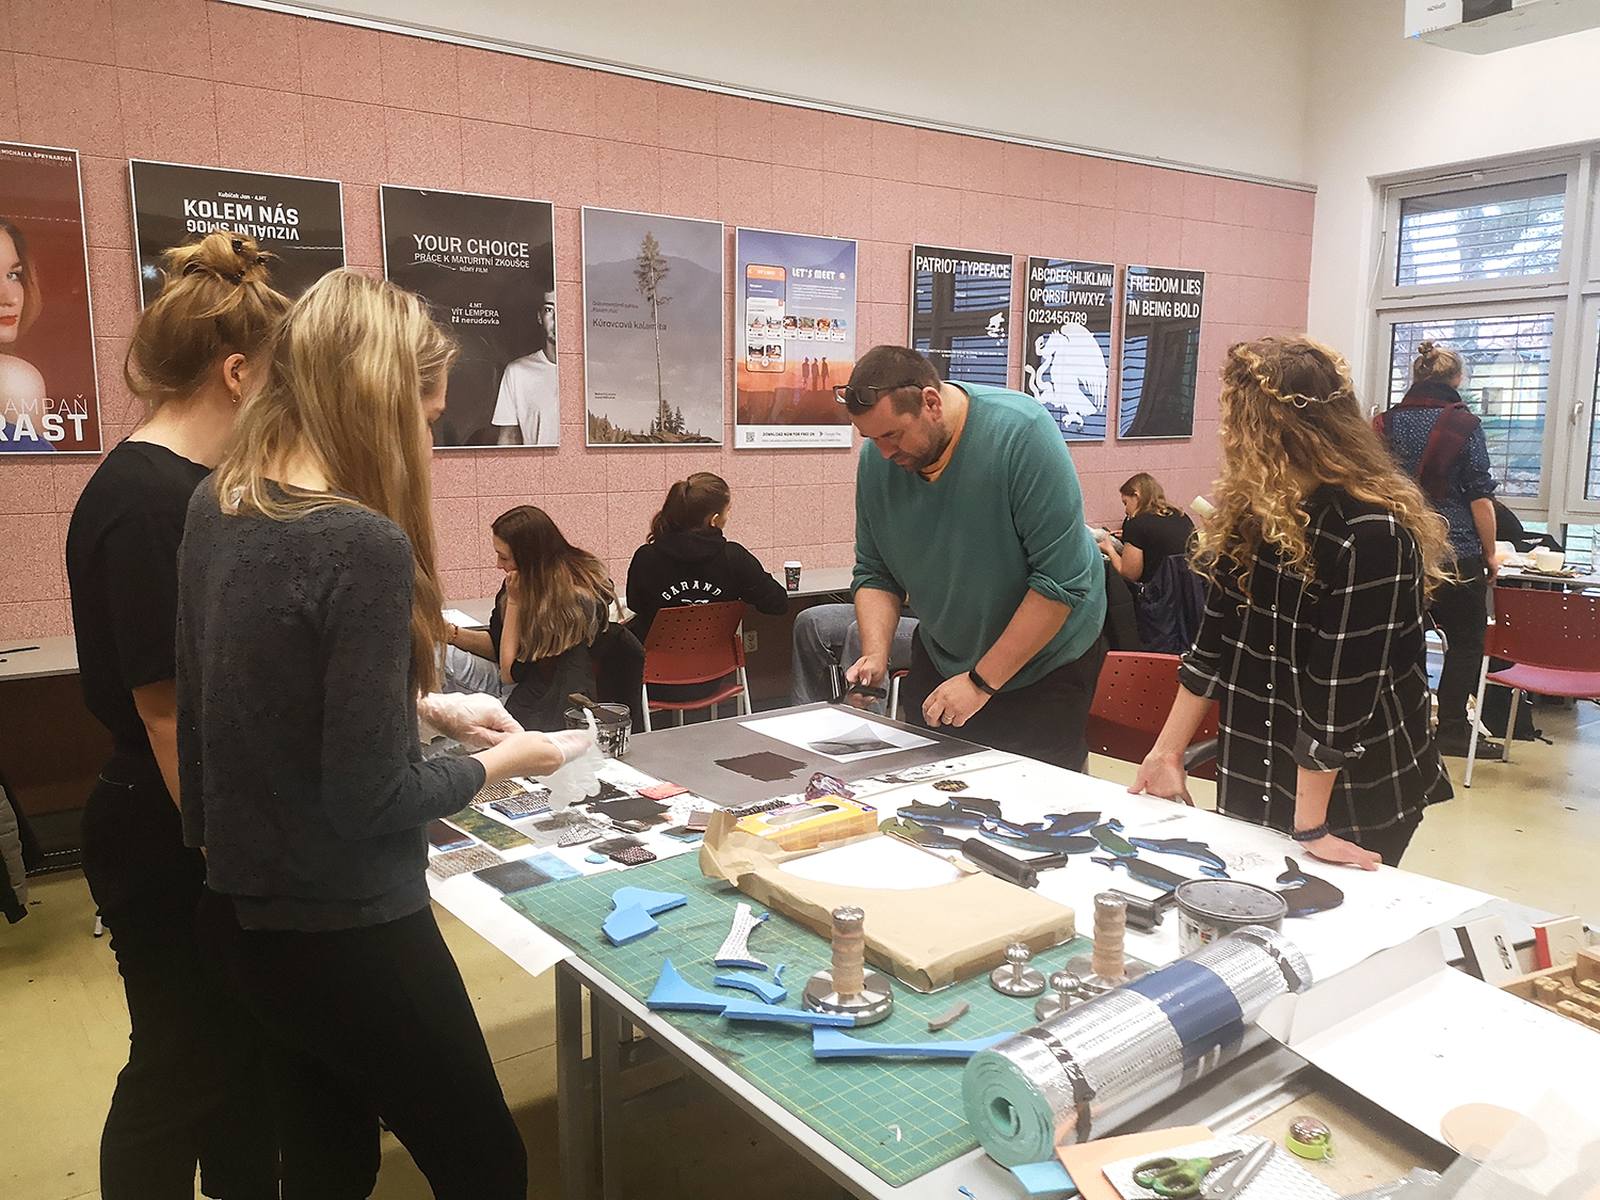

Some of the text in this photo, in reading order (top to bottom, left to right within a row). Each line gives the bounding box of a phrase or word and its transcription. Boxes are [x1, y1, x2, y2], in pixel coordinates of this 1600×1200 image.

[183, 199, 299, 225] KOLEM NÁS
[413, 234, 529, 258] YOUR CHOICE
[414, 252, 530, 269] PRÁCE K MATURITNÍ ZKOUŠCE
[916, 256, 1010, 279] PATRIOT TYPEFACE
[791, 267, 836, 280] LET'S MEET
[1031, 267, 1112, 287] ABCDEFGHIJKLMN
[1130, 275, 1201, 295] FREEDOM LIES
[1030, 288, 1105, 307] OPQRSTUVWXYZ
[451, 307, 499, 318] VÍT LEMPERA
[1029, 309, 1088, 326] 0123456789
[1129, 300, 1200, 318] IN BEING BOLD
[461, 317, 500, 326] nerudovka
[661, 580, 722, 601] GARAND
